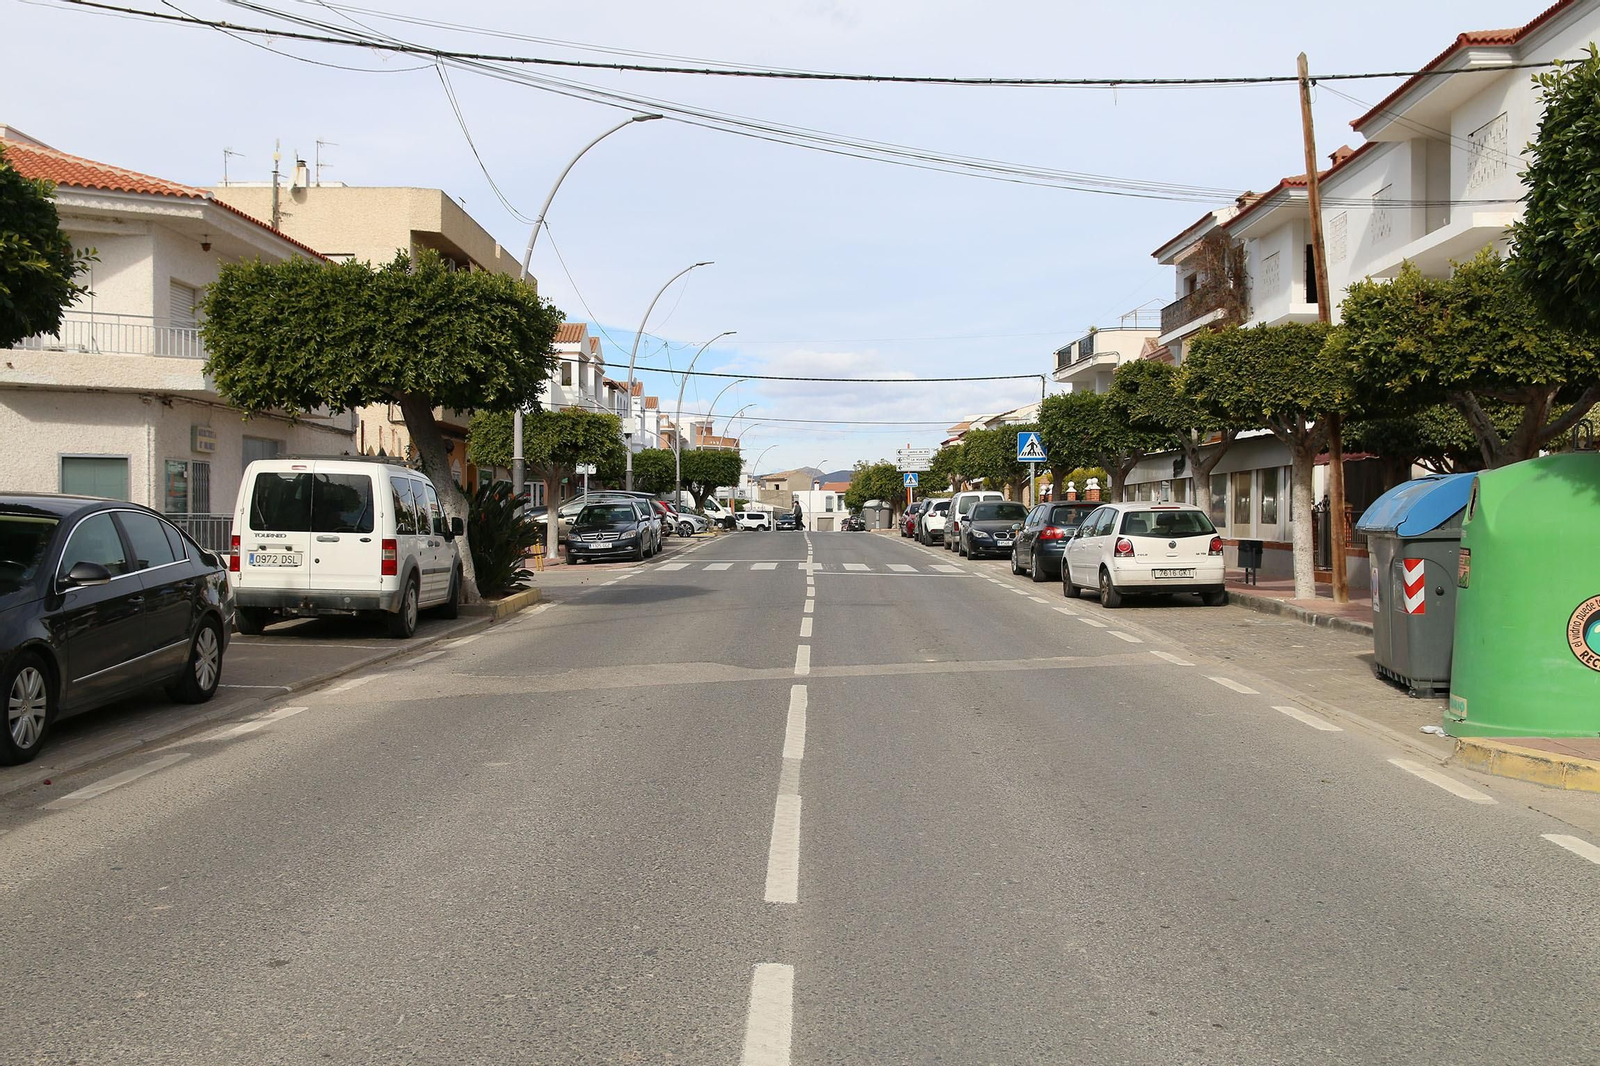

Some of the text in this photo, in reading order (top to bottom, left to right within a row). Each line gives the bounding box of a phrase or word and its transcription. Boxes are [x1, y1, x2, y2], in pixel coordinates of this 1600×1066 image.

[255, 555, 298, 564] 0972 DSL
[1569, 602, 1596, 648] el vidrio puede
[1580, 650, 1600, 669] REC
